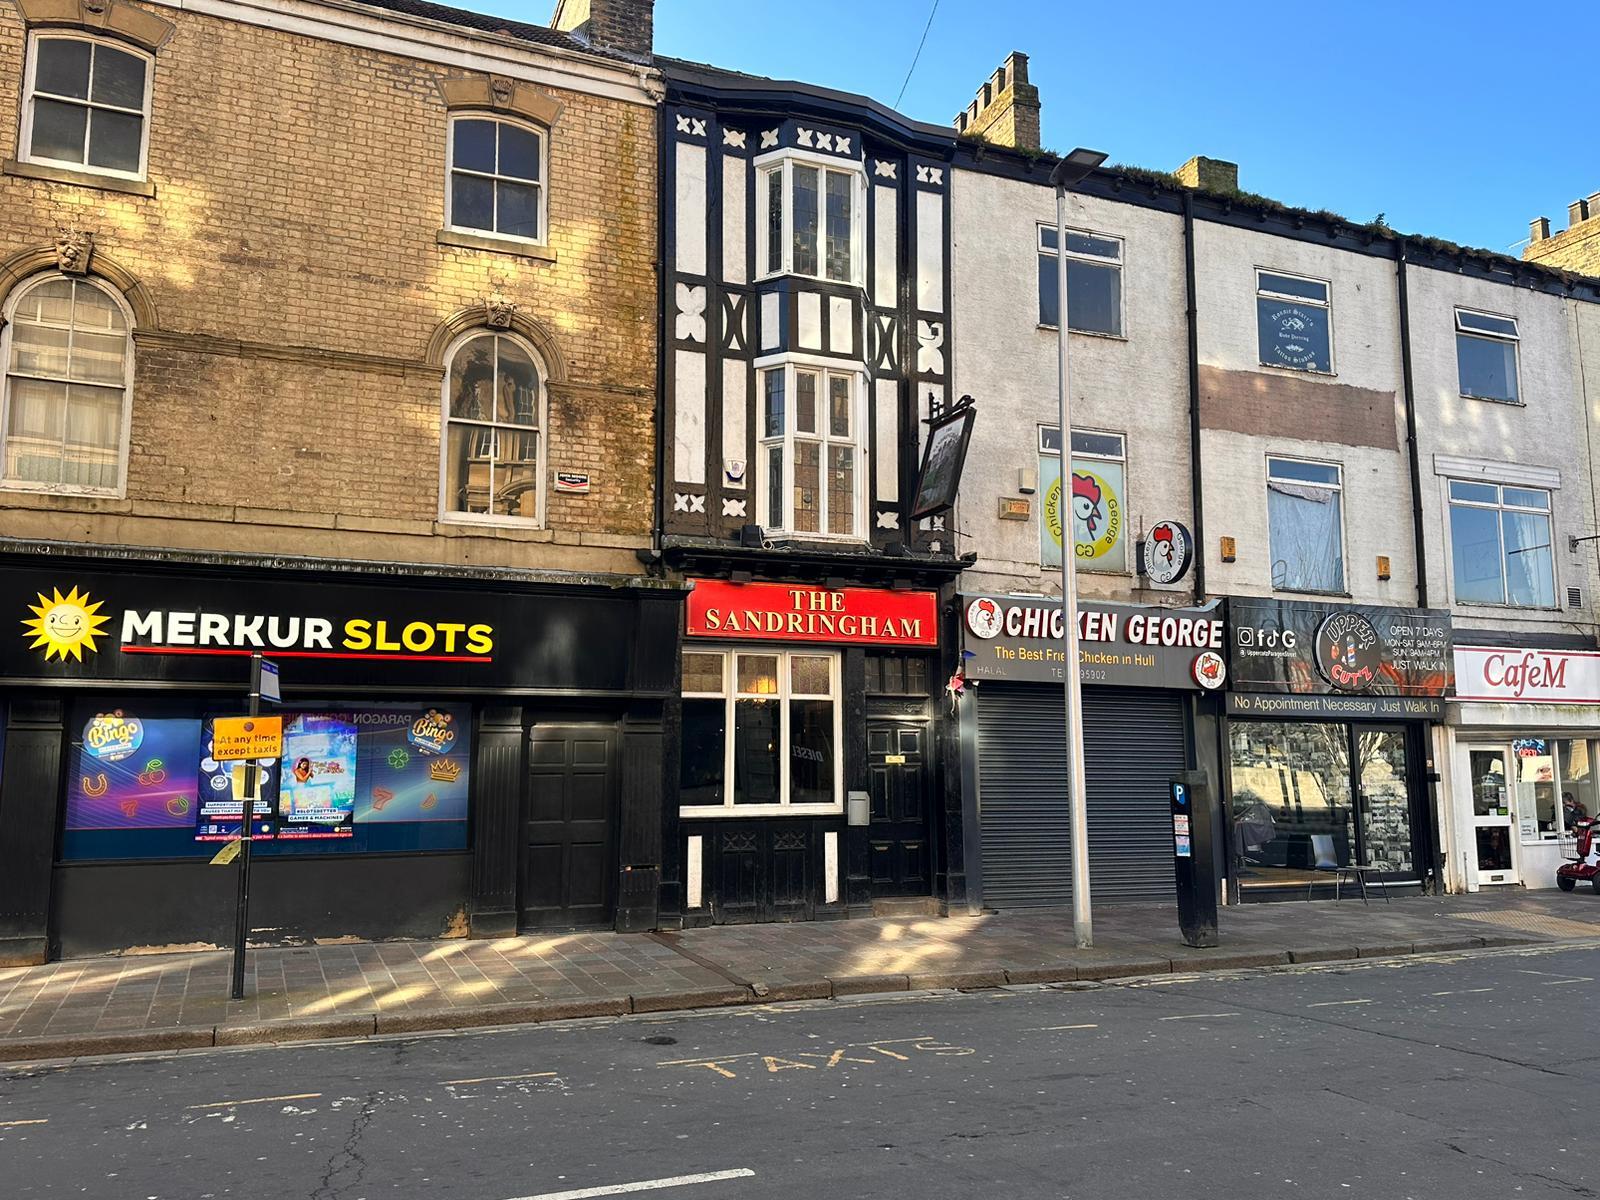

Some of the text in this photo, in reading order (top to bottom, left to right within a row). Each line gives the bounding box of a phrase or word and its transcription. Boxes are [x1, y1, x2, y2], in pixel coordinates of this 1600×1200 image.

[1105, 499, 1118, 544] George
[1144, 540, 1154, 575] Chicken
[1177, 532, 1185, 566] George
[789, 590, 846, 612] THE
[121, 610, 494, 654] MERKUR SLOTS
[705, 609, 921, 638] SANDRINGHAM
[1128, 614, 1223, 648] GEORGE
[1326, 615, 1376, 650] UPPER
[1390, 626, 1444, 637] OPEN 7 DAYS
[1385, 639, 1415, 647] MON-SAT
[1392, 649, 1408, 657] SUN
[995, 646, 1155, 666] The Best Frie Chicken in Hull
[1391, 660, 1447, 671] JUST WALK IN
[977, 666, 1106, 679] HALAL TE 95902
[1484, 653, 1568, 697] CafeM
[1234, 697, 1440, 714] No Appointment Necessary Just Walk In
[88, 723, 137, 748] Bingo
[219, 733, 277, 745] At any time
[412, 718, 454, 744] Bingo
[217, 745, 277, 756] except taxis
[1176, 785, 1184, 801] P
